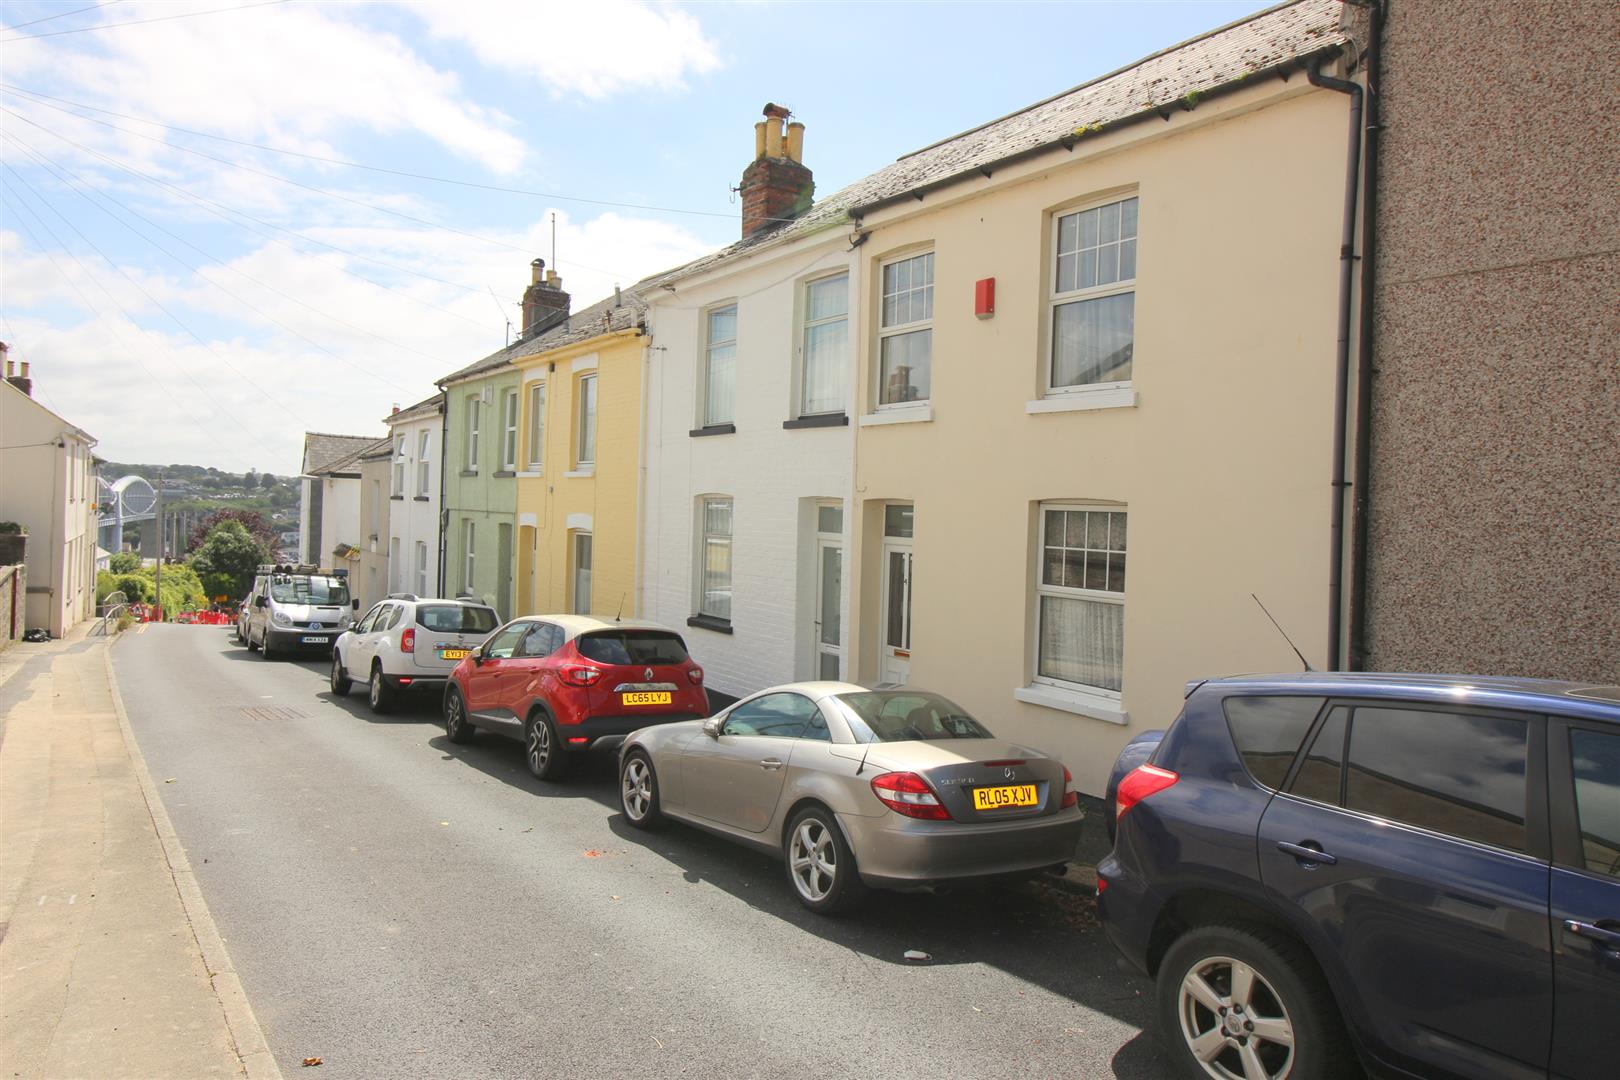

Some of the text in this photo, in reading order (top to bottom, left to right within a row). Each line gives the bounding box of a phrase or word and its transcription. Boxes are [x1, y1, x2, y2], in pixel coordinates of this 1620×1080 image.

[626, 693, 667, 703] LC65 LYJ
[979, 789, 1009, 805] RL05
